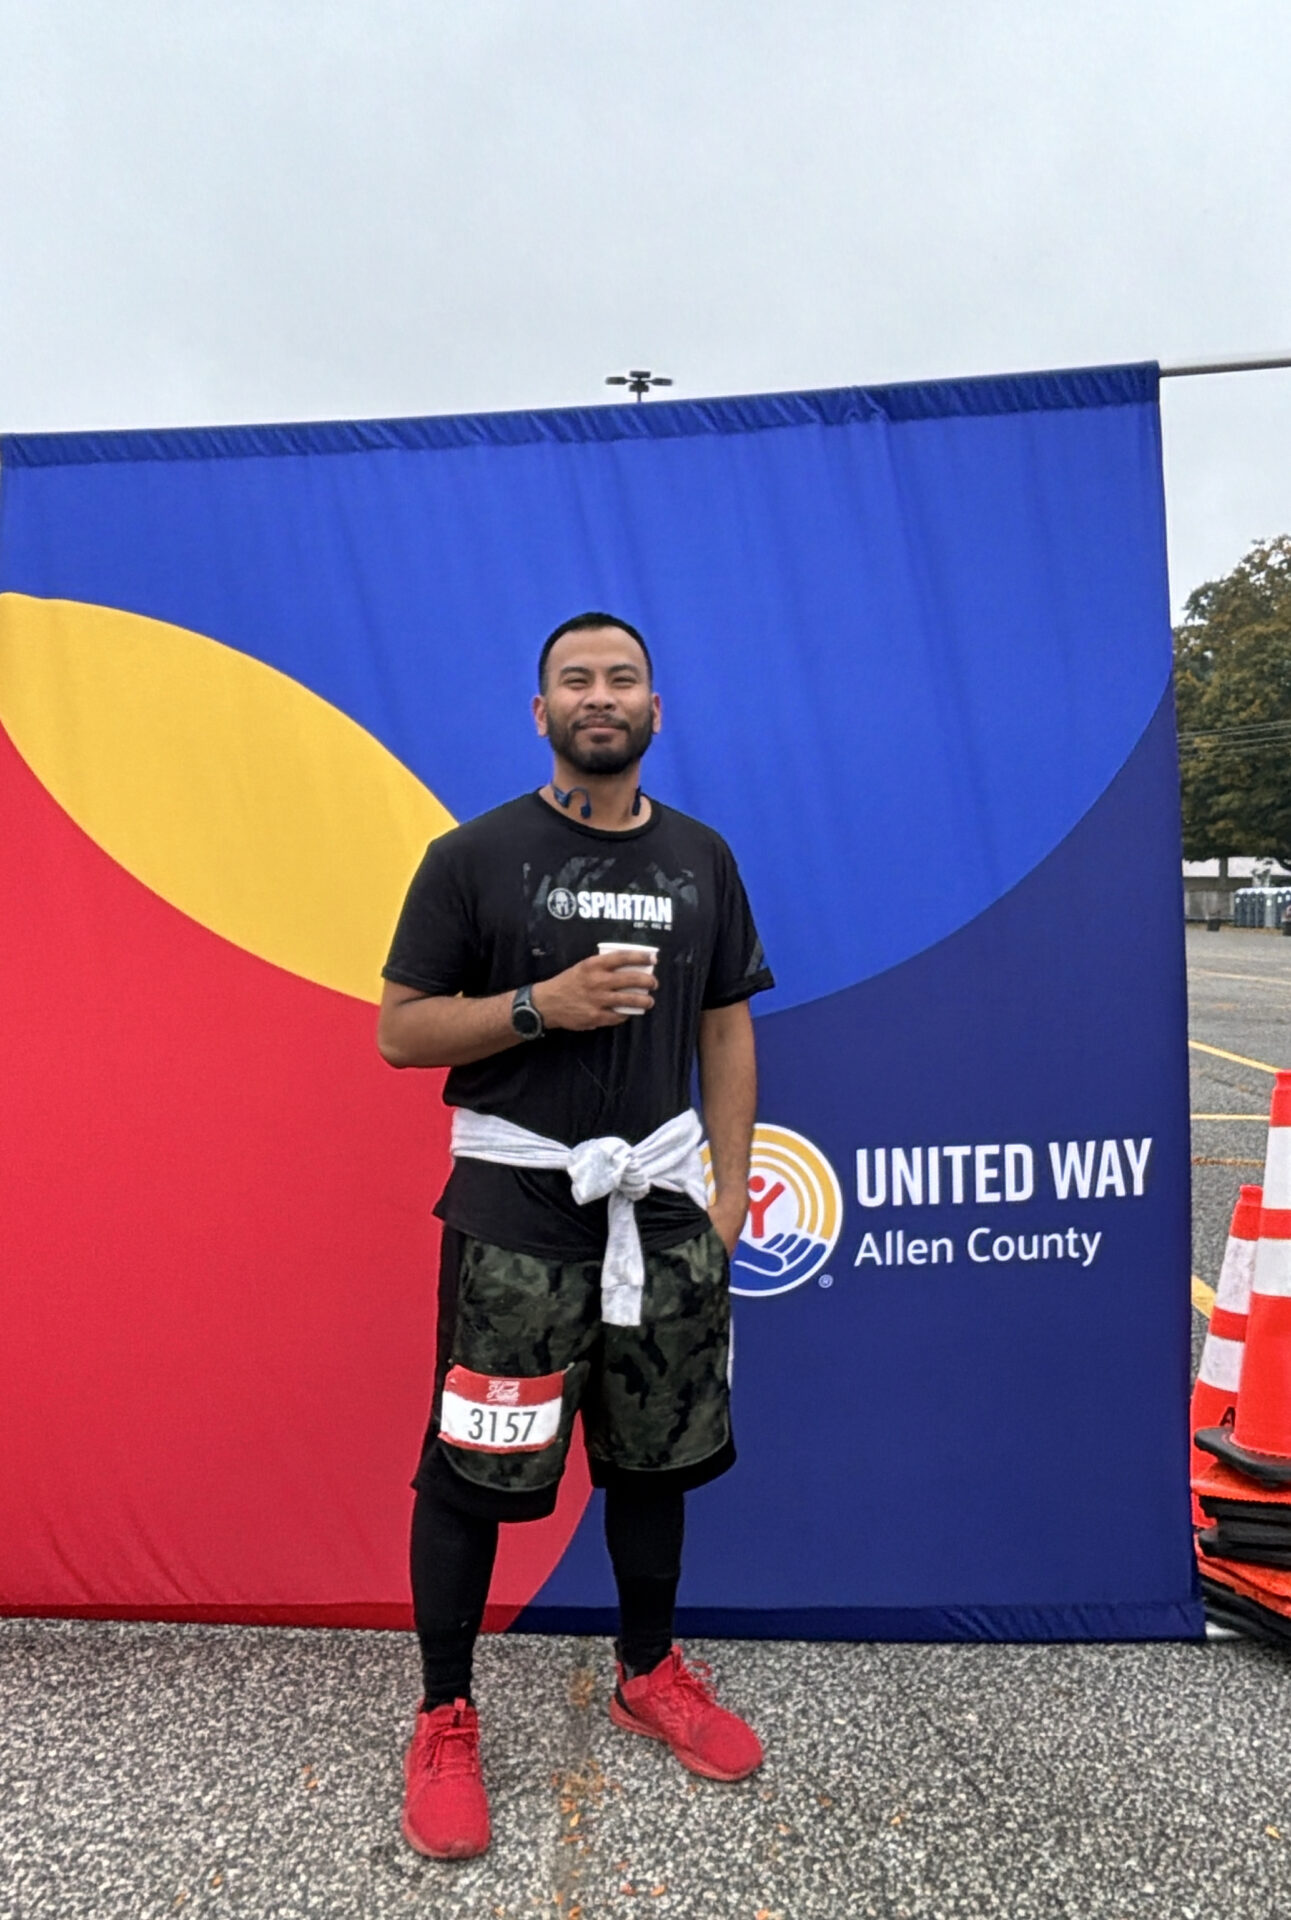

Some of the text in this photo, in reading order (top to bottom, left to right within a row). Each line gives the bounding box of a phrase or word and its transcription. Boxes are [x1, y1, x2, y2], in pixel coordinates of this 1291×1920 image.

[577, 890, 673, 924] SPARTAN
[855, 1137, 1153, 1208] UNITED WAY
[854, 1226, 1102, 1267] Allen County
[468, 1408, 538, 1443] 3157
